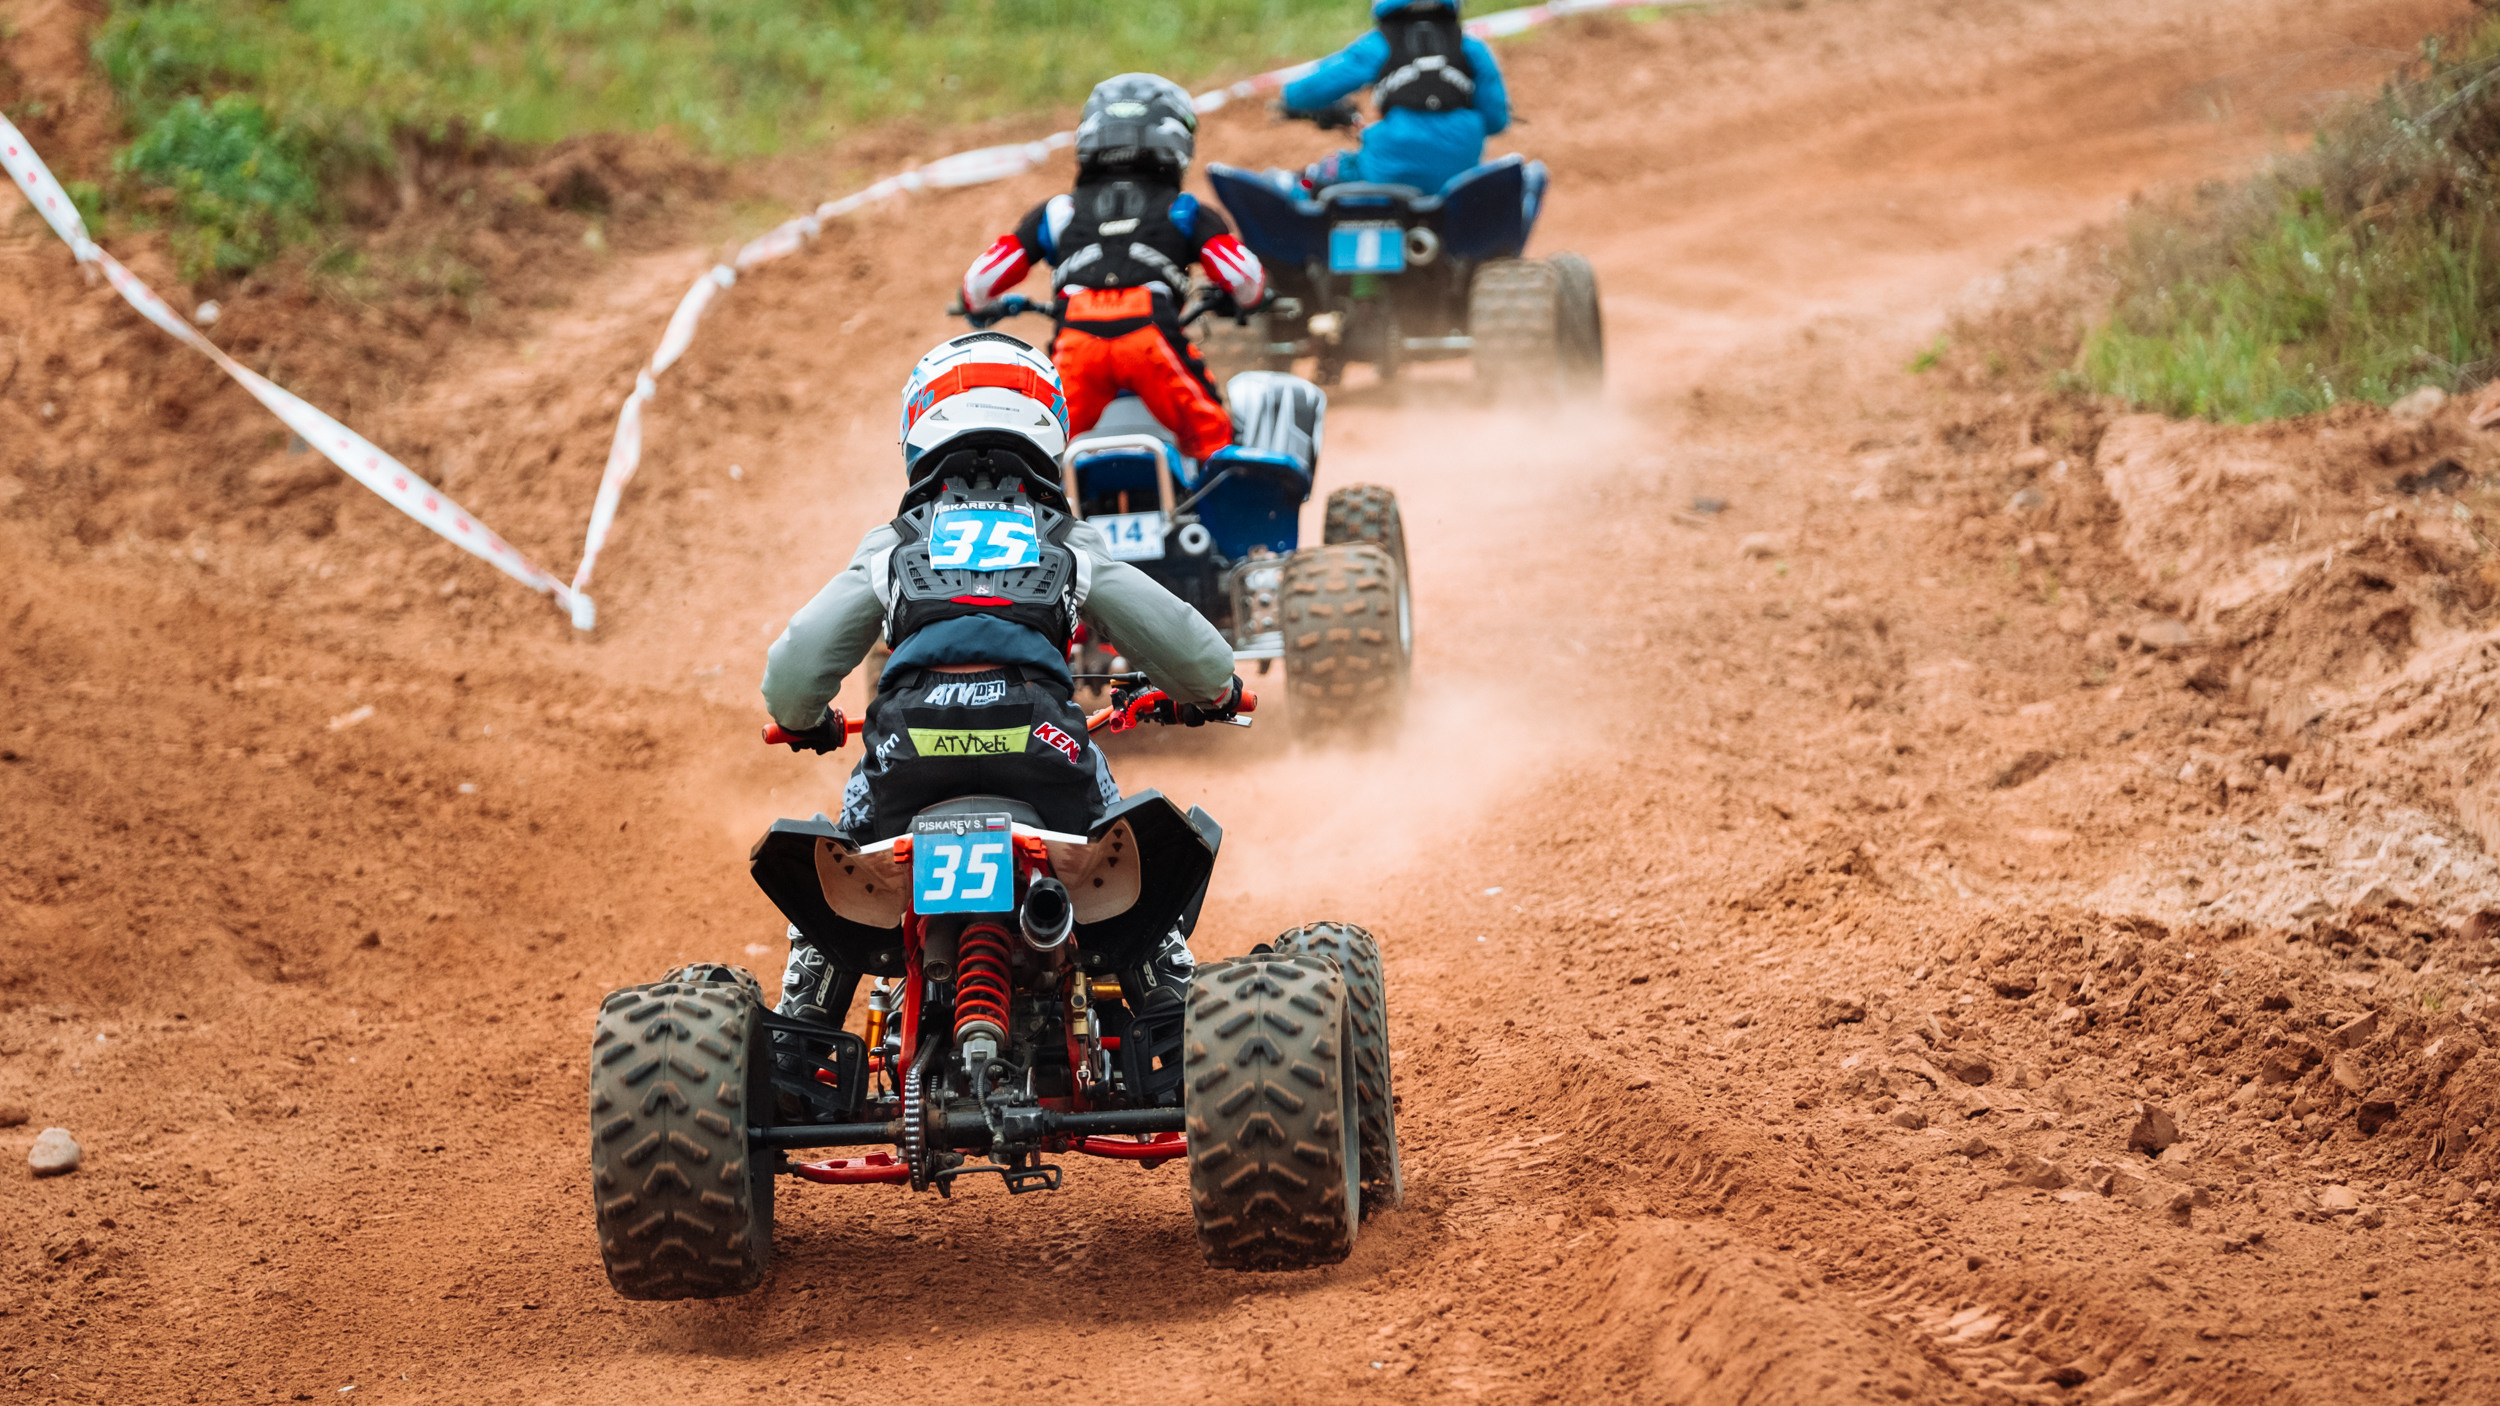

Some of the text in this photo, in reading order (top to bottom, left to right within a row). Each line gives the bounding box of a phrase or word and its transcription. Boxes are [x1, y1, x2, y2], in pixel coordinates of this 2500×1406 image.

[998, 503, 1011, 512] S.
[931, 519, 1035, 568] 35
[1105, 521, 1143, 545] 14
[933, 733, 1010, 754] ATVDeti
[918, 819, 984, 831] PISKAREV S.
[922, 843, 1005, 901] 35
